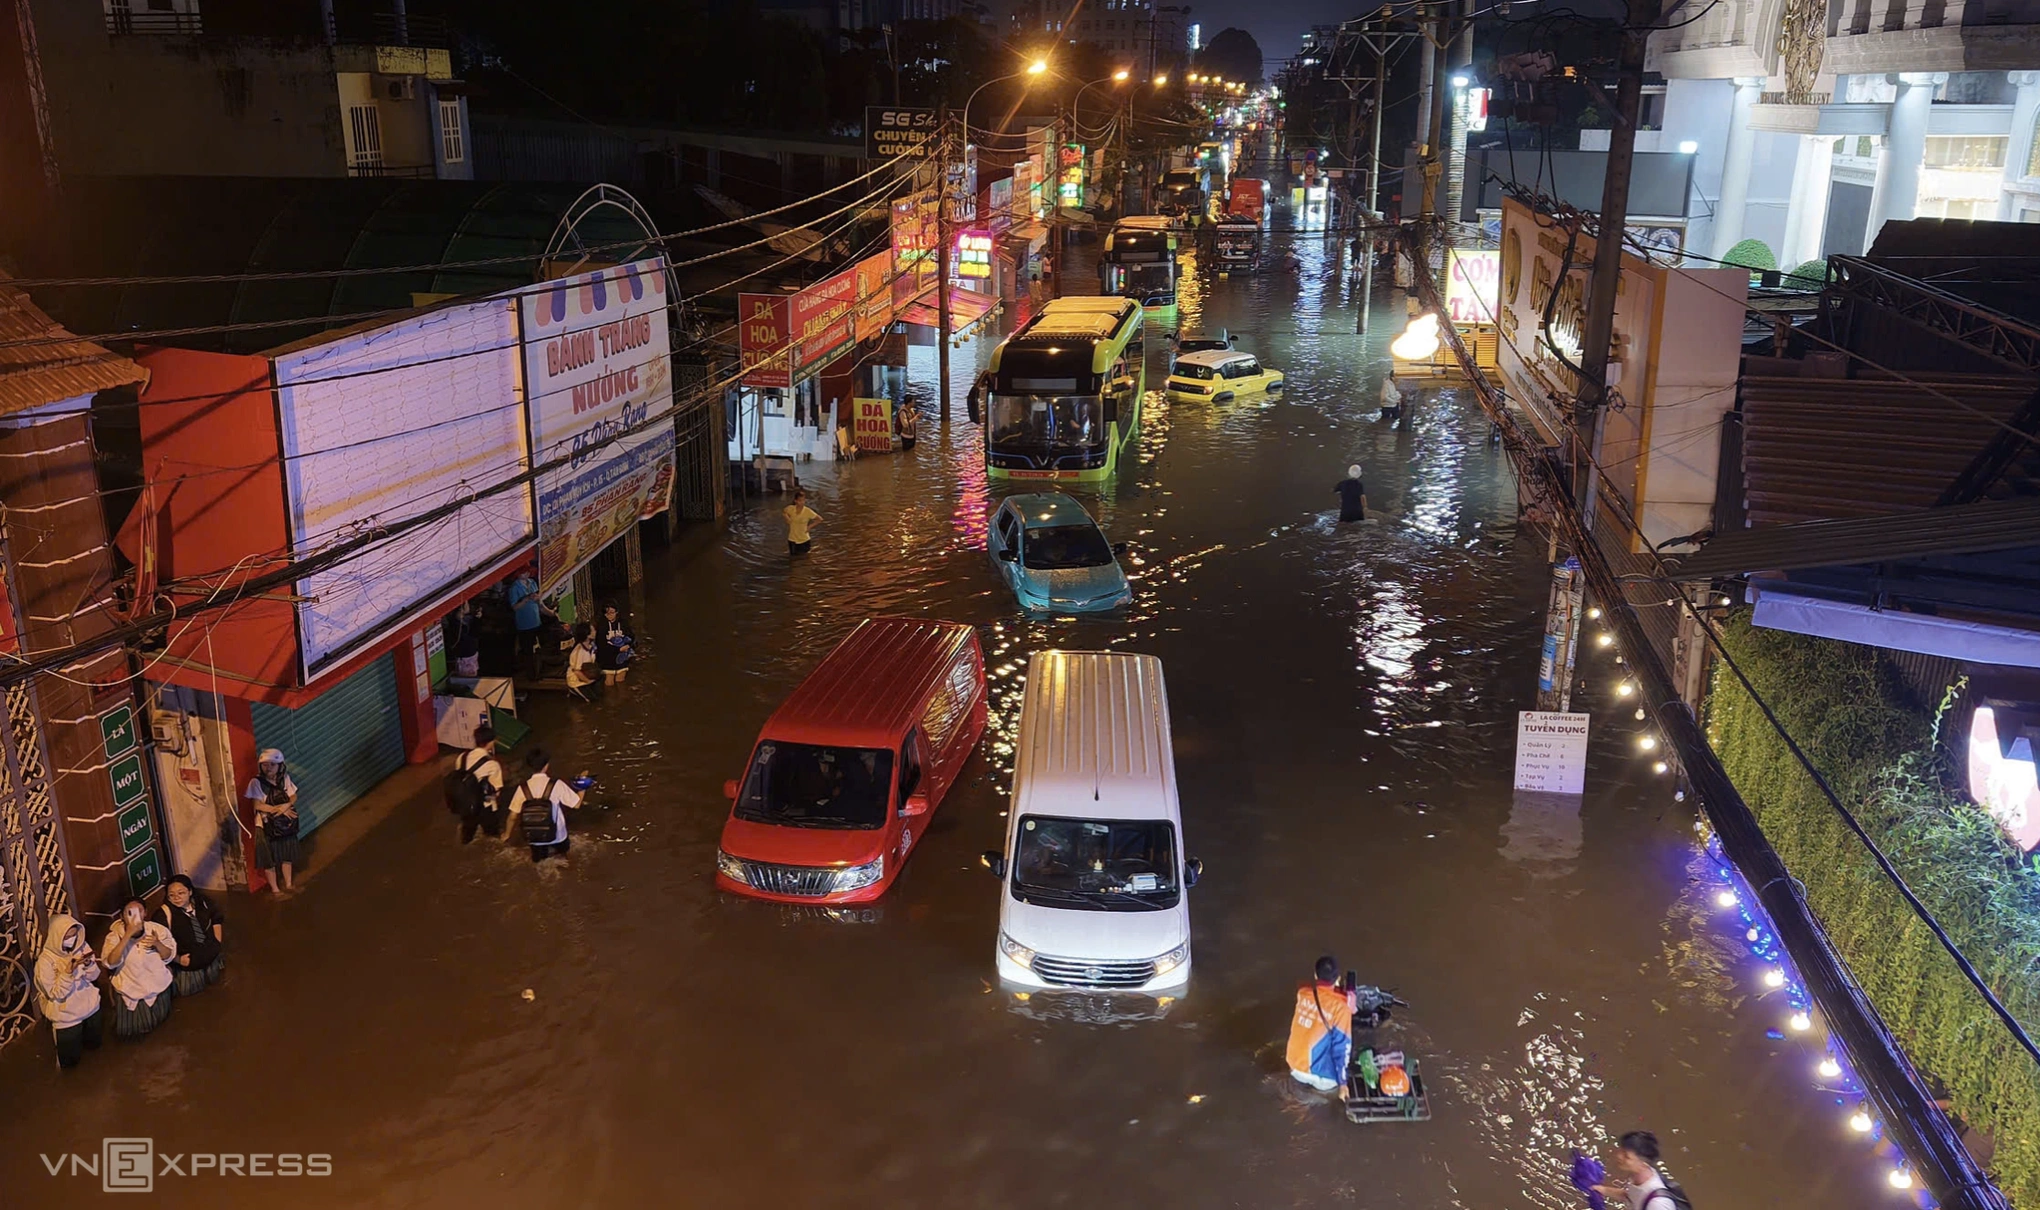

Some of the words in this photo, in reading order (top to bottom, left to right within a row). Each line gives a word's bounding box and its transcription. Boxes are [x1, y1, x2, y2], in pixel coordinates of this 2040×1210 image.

[881, 111, 911, 126] SG
[873, 129, 926, 142] CHUYÊN
[754, 297, 774, 320] ĐÁ
[547, 325, 596, 377] BÁNH
[598, 307, 651, 359] TRÁNG
[750, 325, 779, 343] HOA
[572, 364, 639, 415] NƯỚNG
[861, 401, 884, 417] ĐÁ
[856, 419, 889, 432] HOA
[594, 487, 622, 510] PHAN
[111, 724, 126, 739] LÀ
[1524, 721, 1556, 732] TUYỂN
[1557, 727, 1586, 735] DỤNG
[115, 769, 138, 791] MỘT
[123, 815, 148, 839] NGÀY
[135, 865, 153, 881] VUI
